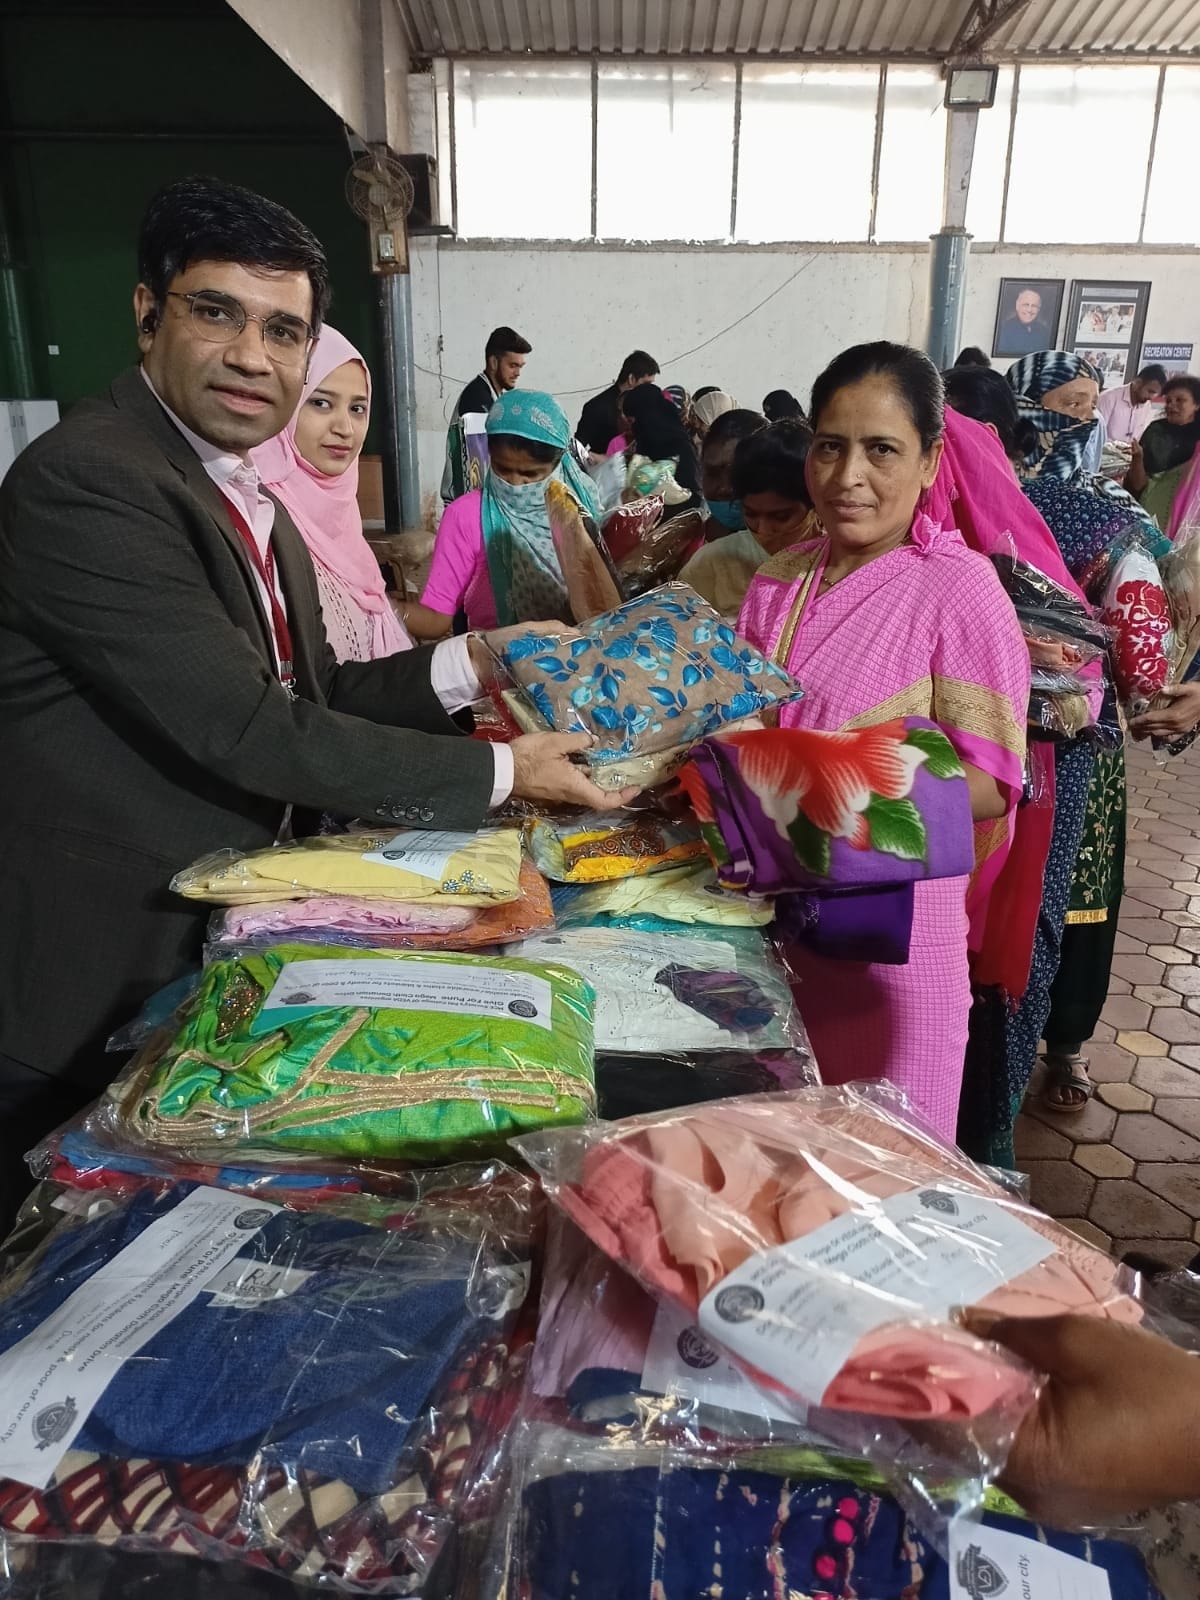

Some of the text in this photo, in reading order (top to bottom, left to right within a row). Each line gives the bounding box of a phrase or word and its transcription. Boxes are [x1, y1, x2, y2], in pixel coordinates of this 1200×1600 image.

[1144, 346, 1192, 357] RECREATION CENTRE
[202, 1246, 218, 1259] For
[179, 1259, 205, 1280] Pune
[156, 1282, 180, 1304] Mega
[135, 1303, 160, 1321] Cloth
[97, 1319, 138, 1350] Donation
[77, 1349, 102, 1373] Drive
[36, 1363, 58, 1387] poor
[28, 1388, 39, 1400] of
[15, 1401, 31, 1420] our
[1022, 1579, 1032, 1600] our
